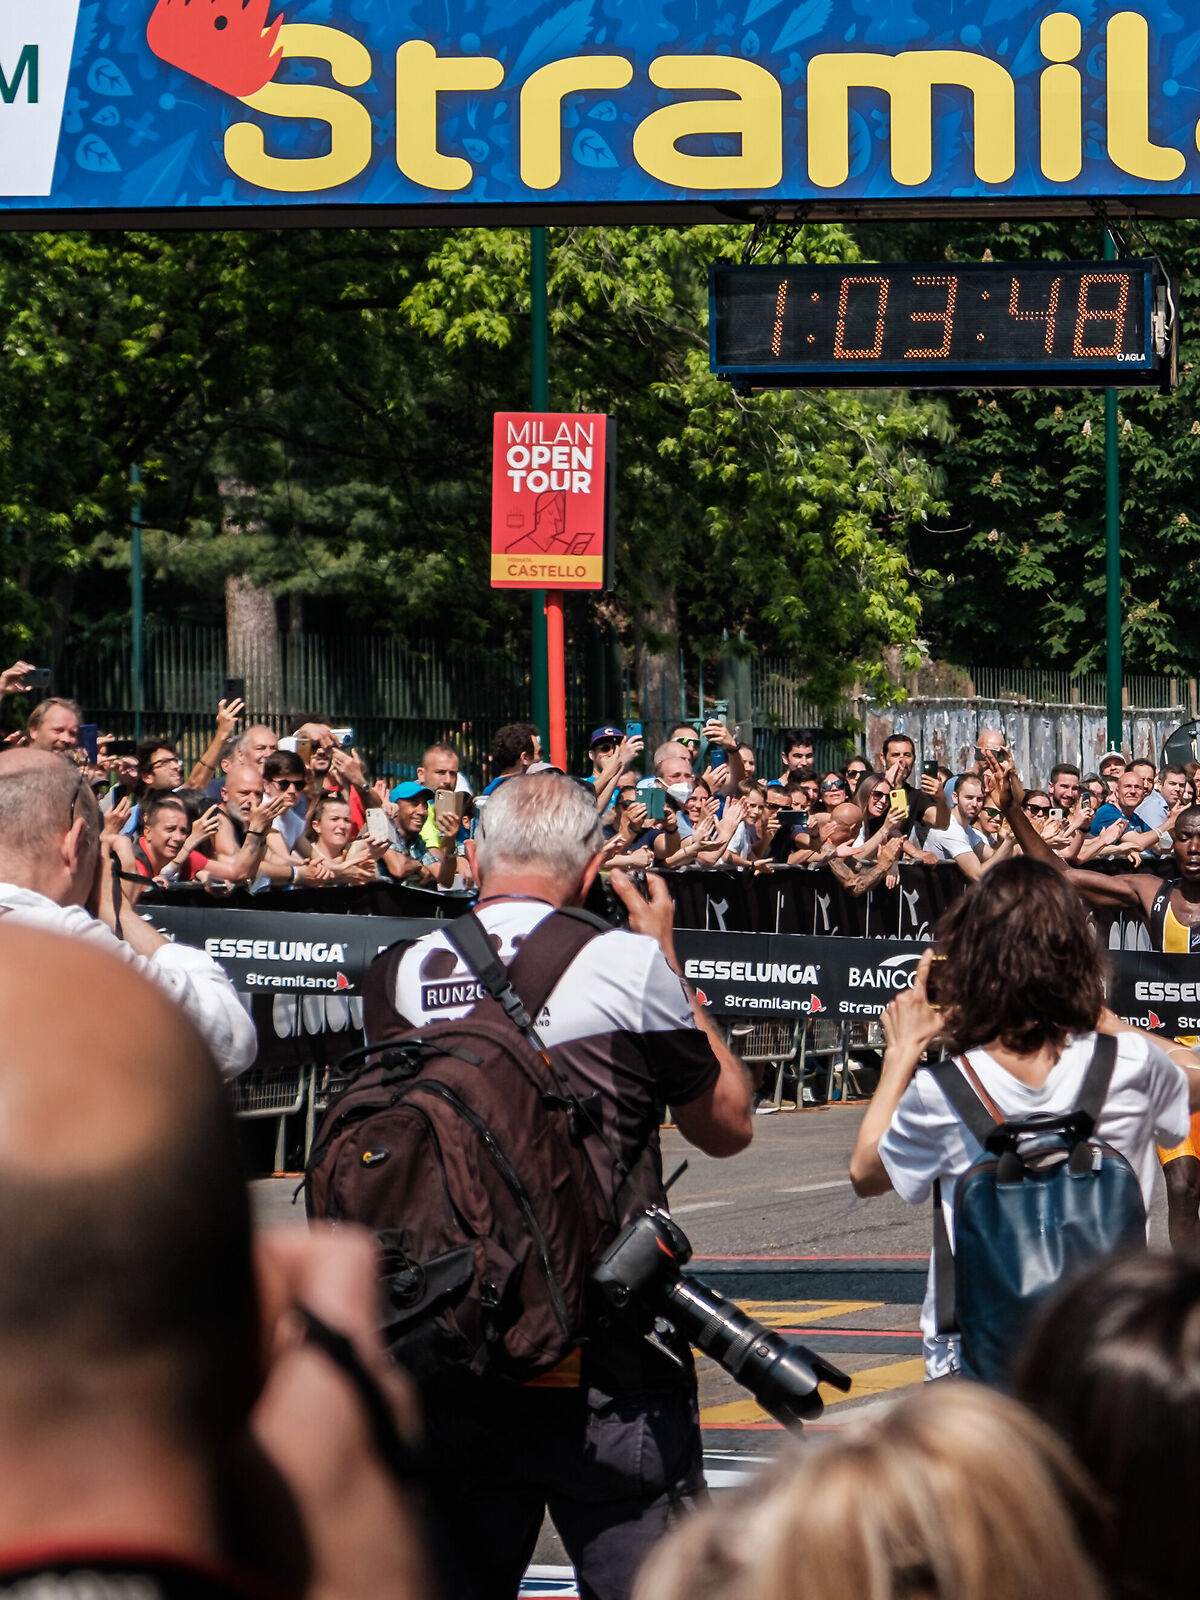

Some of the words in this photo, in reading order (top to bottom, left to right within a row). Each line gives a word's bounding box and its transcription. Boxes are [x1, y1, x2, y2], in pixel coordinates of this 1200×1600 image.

[770, 273, 1131, 359] 1:03:48
[507, 421, 594, 445] MILAN
[506, 445, 593, 470] OPEN
[507, 470, 591, 494] TOUR
[507, 564, 586, 578] CASTELLO
[205, 938, 345, 963] ESSELUNGA
[246, 972, 338, 988] Stramilano
[684, 959, 818, 985] ESSELUNGA
[724, 995, 811, 1011] Stramilano
[839, 1001, 889, 1014] Stram
